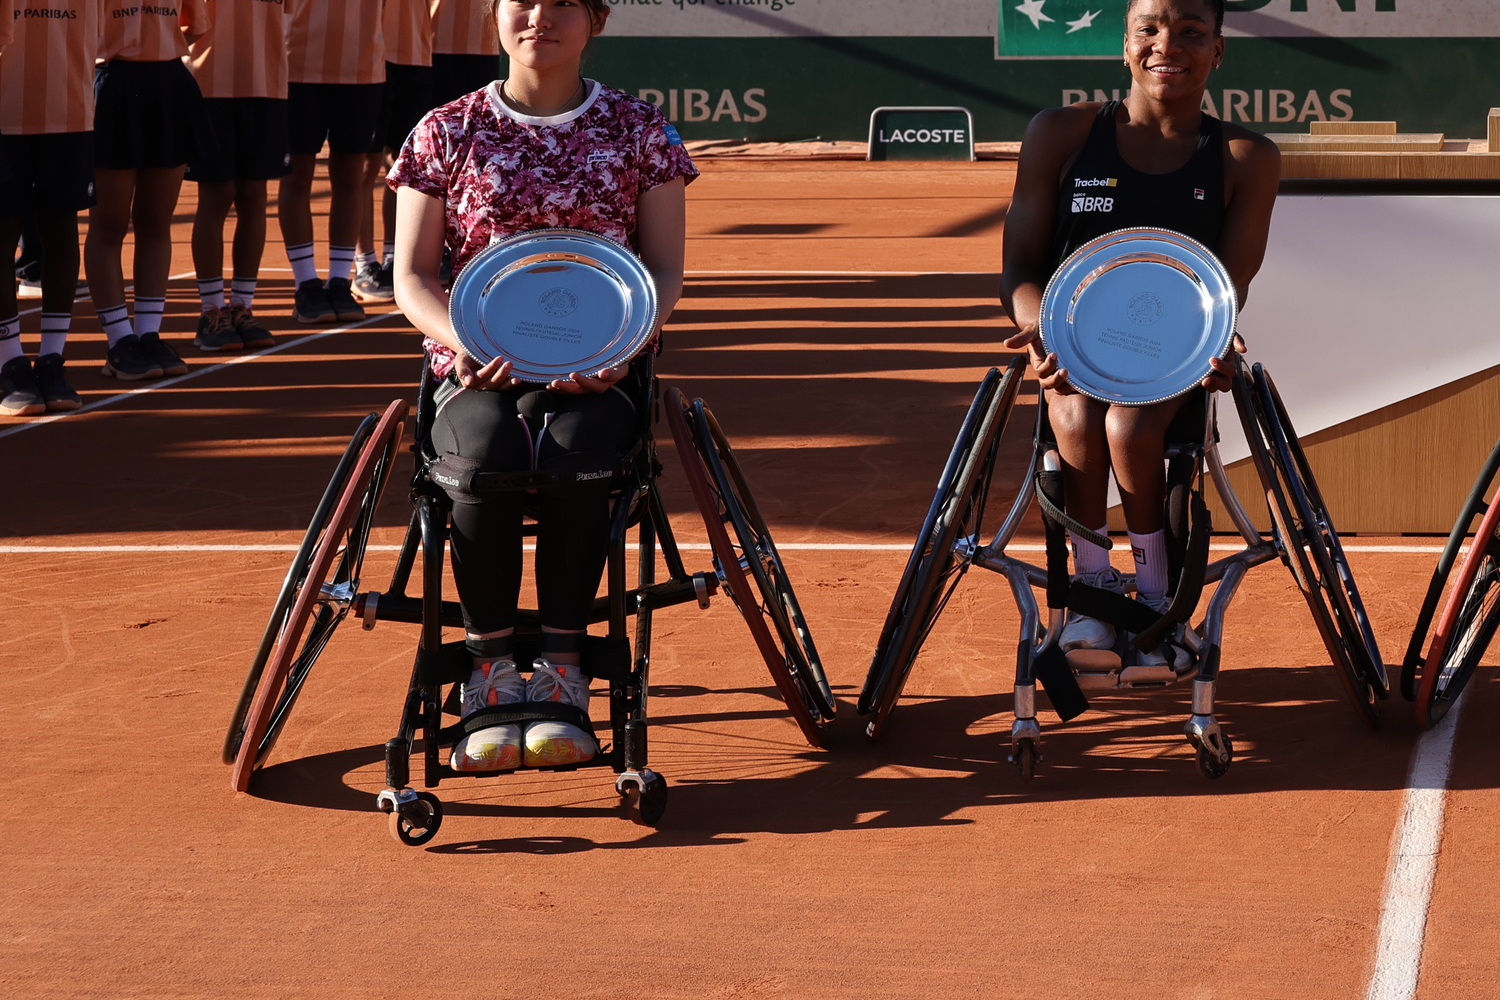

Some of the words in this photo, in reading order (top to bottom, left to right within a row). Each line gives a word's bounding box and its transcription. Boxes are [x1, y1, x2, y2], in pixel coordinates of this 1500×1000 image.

[24, 8, 77, 20] PARIBAS
[112, 6, 139, 19] BNP
[141, 5, 178, 17] PARIBA
[879, 129, 965, 144] LACOSTE
[1074, 178, 1110, 188] Tracbel
[1084, 197, 1115, 213] BRB
[520, 321, 543, 329] ROLAND
[543, 324, 567, 332] GARROS
[512, 330, 539, 339] FINALISTE
[540, 334, 562, 342] DOUBLE
[1106, 327, 1127, 337] ROLAND
[1127, 333, 1149, 342] GARROS
[1098, 337, 1121, 348] FINALISTE
[1122, 344, 1143, 354] DOUBLE
[1143, 350, 1160, 359] FILLES
[1143, 343, 1162, 353] JUNIOR
